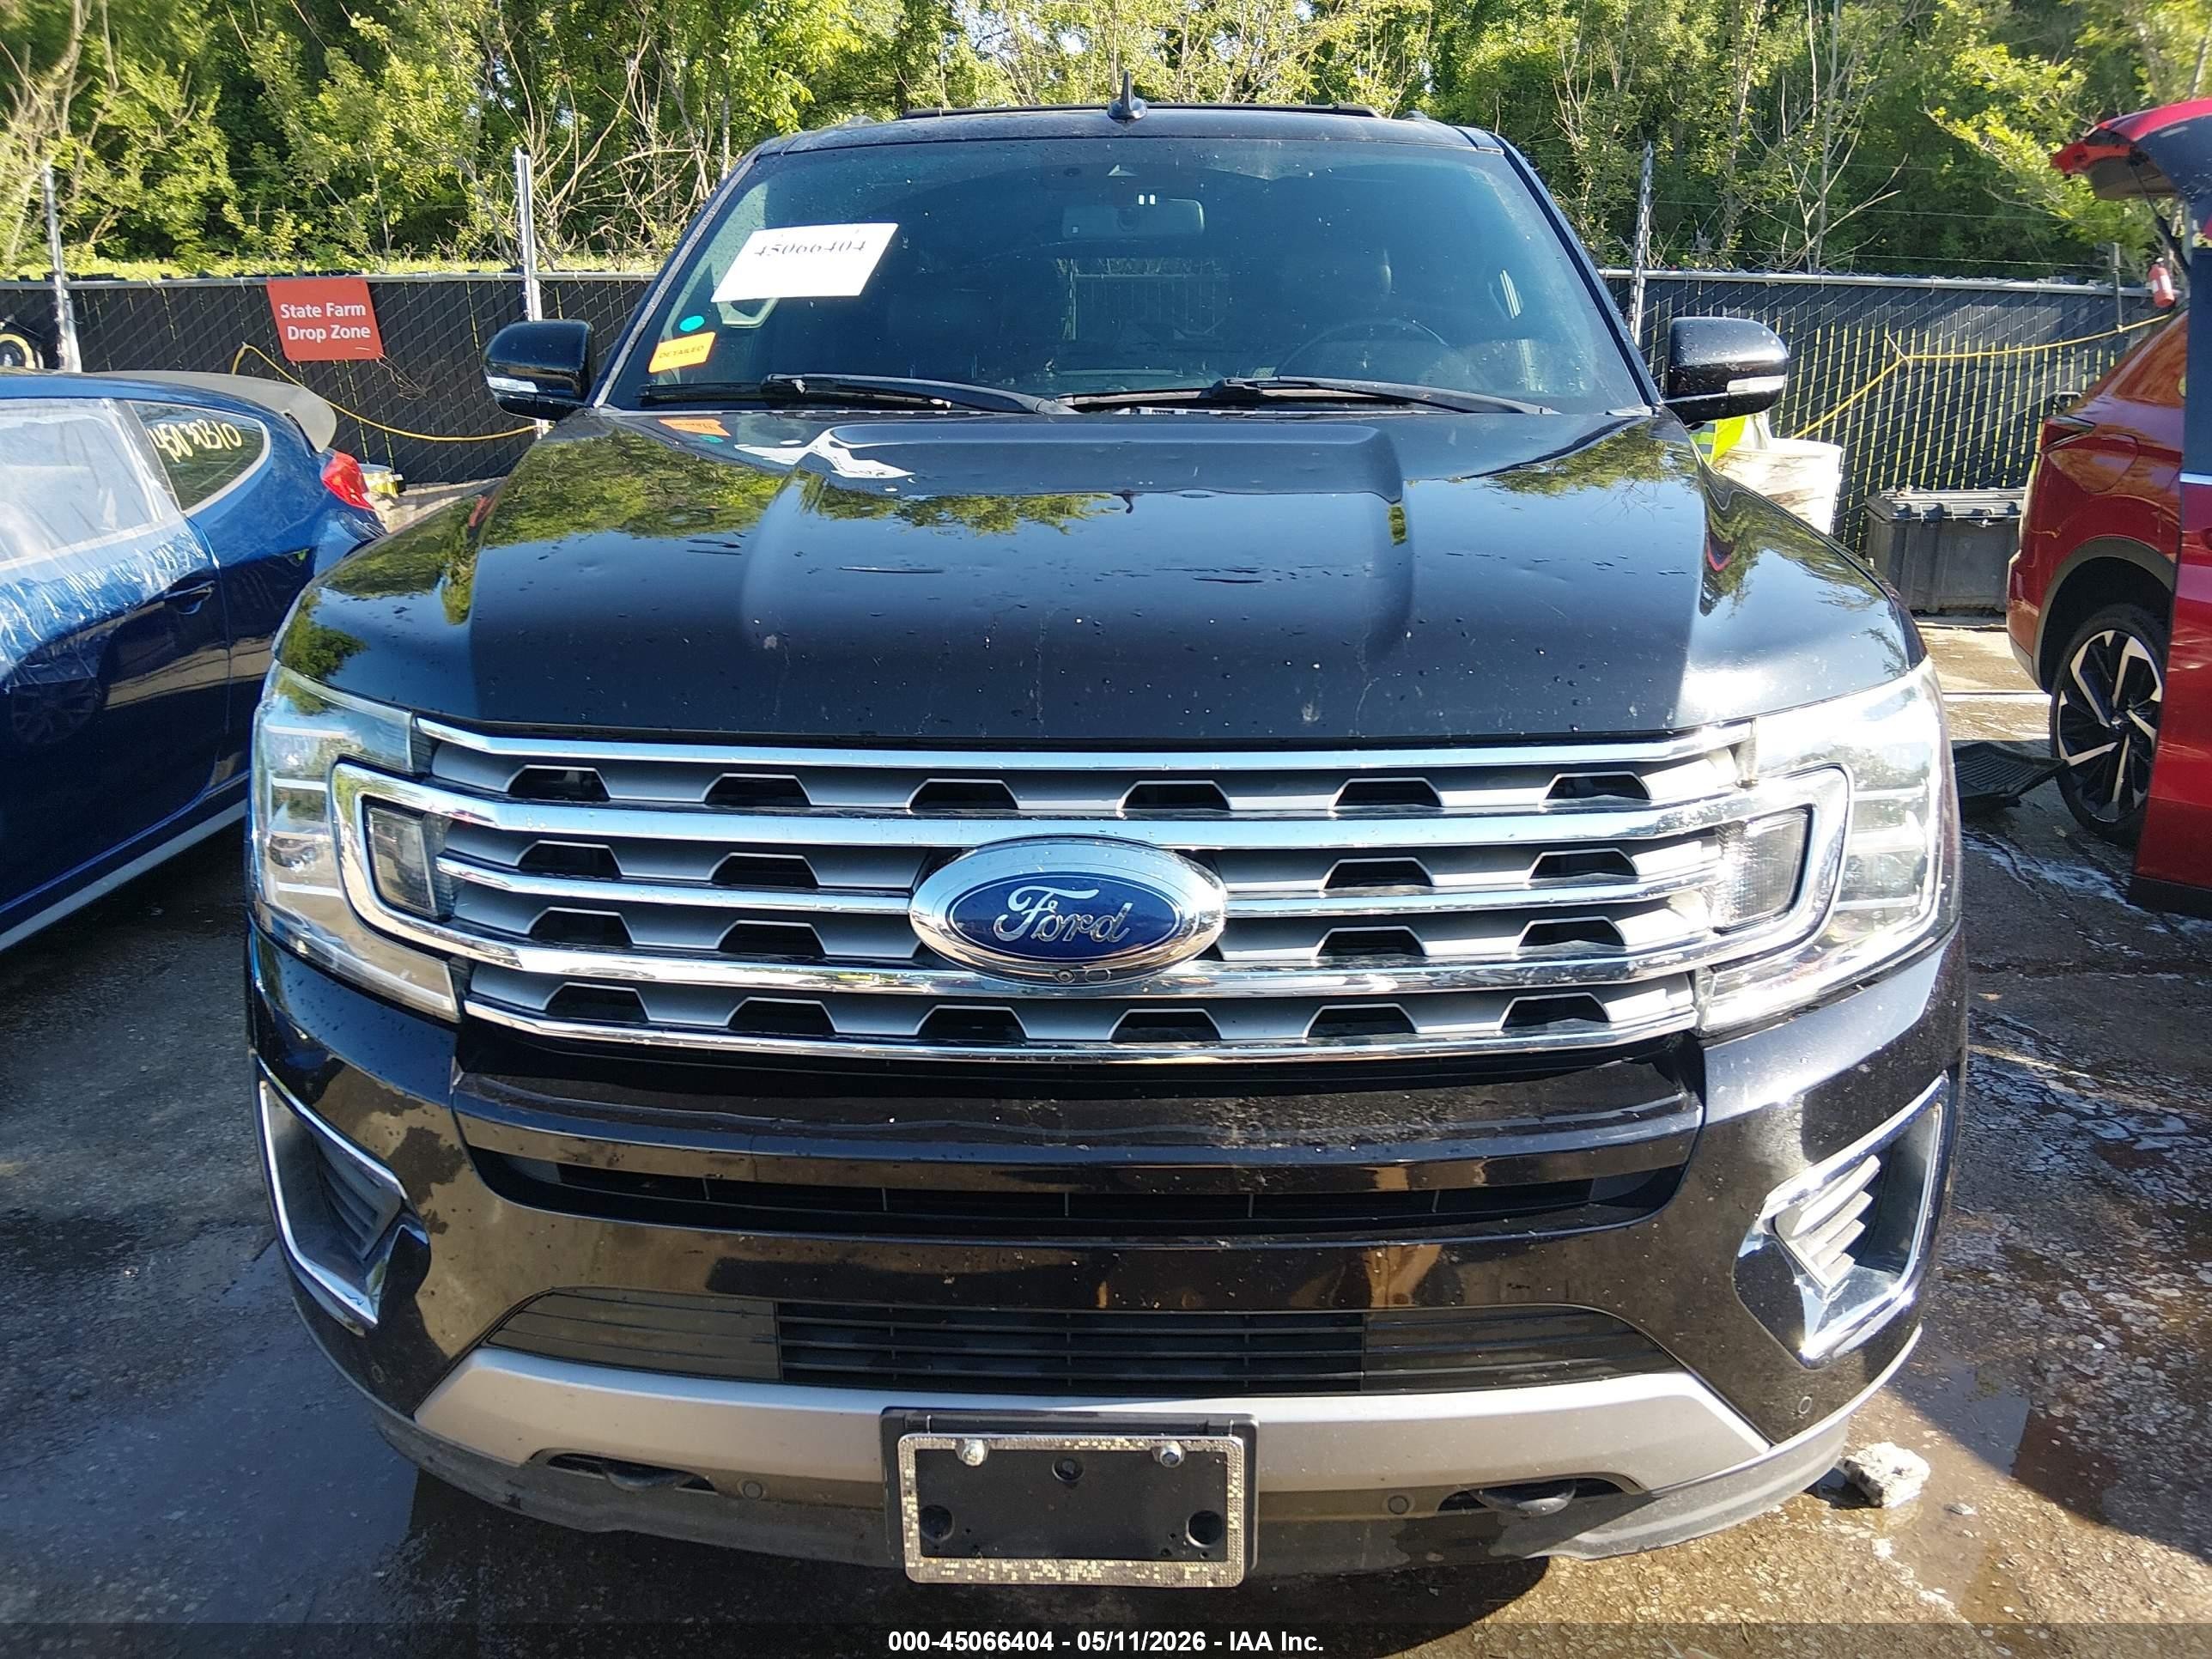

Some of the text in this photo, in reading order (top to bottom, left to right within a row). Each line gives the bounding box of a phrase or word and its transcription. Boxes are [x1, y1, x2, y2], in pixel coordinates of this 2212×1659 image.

[280, 302, 367, 319] State Farm
[287, 324, 371, 343] Drop Zone
[993, 885, 1133, 943] Ford
